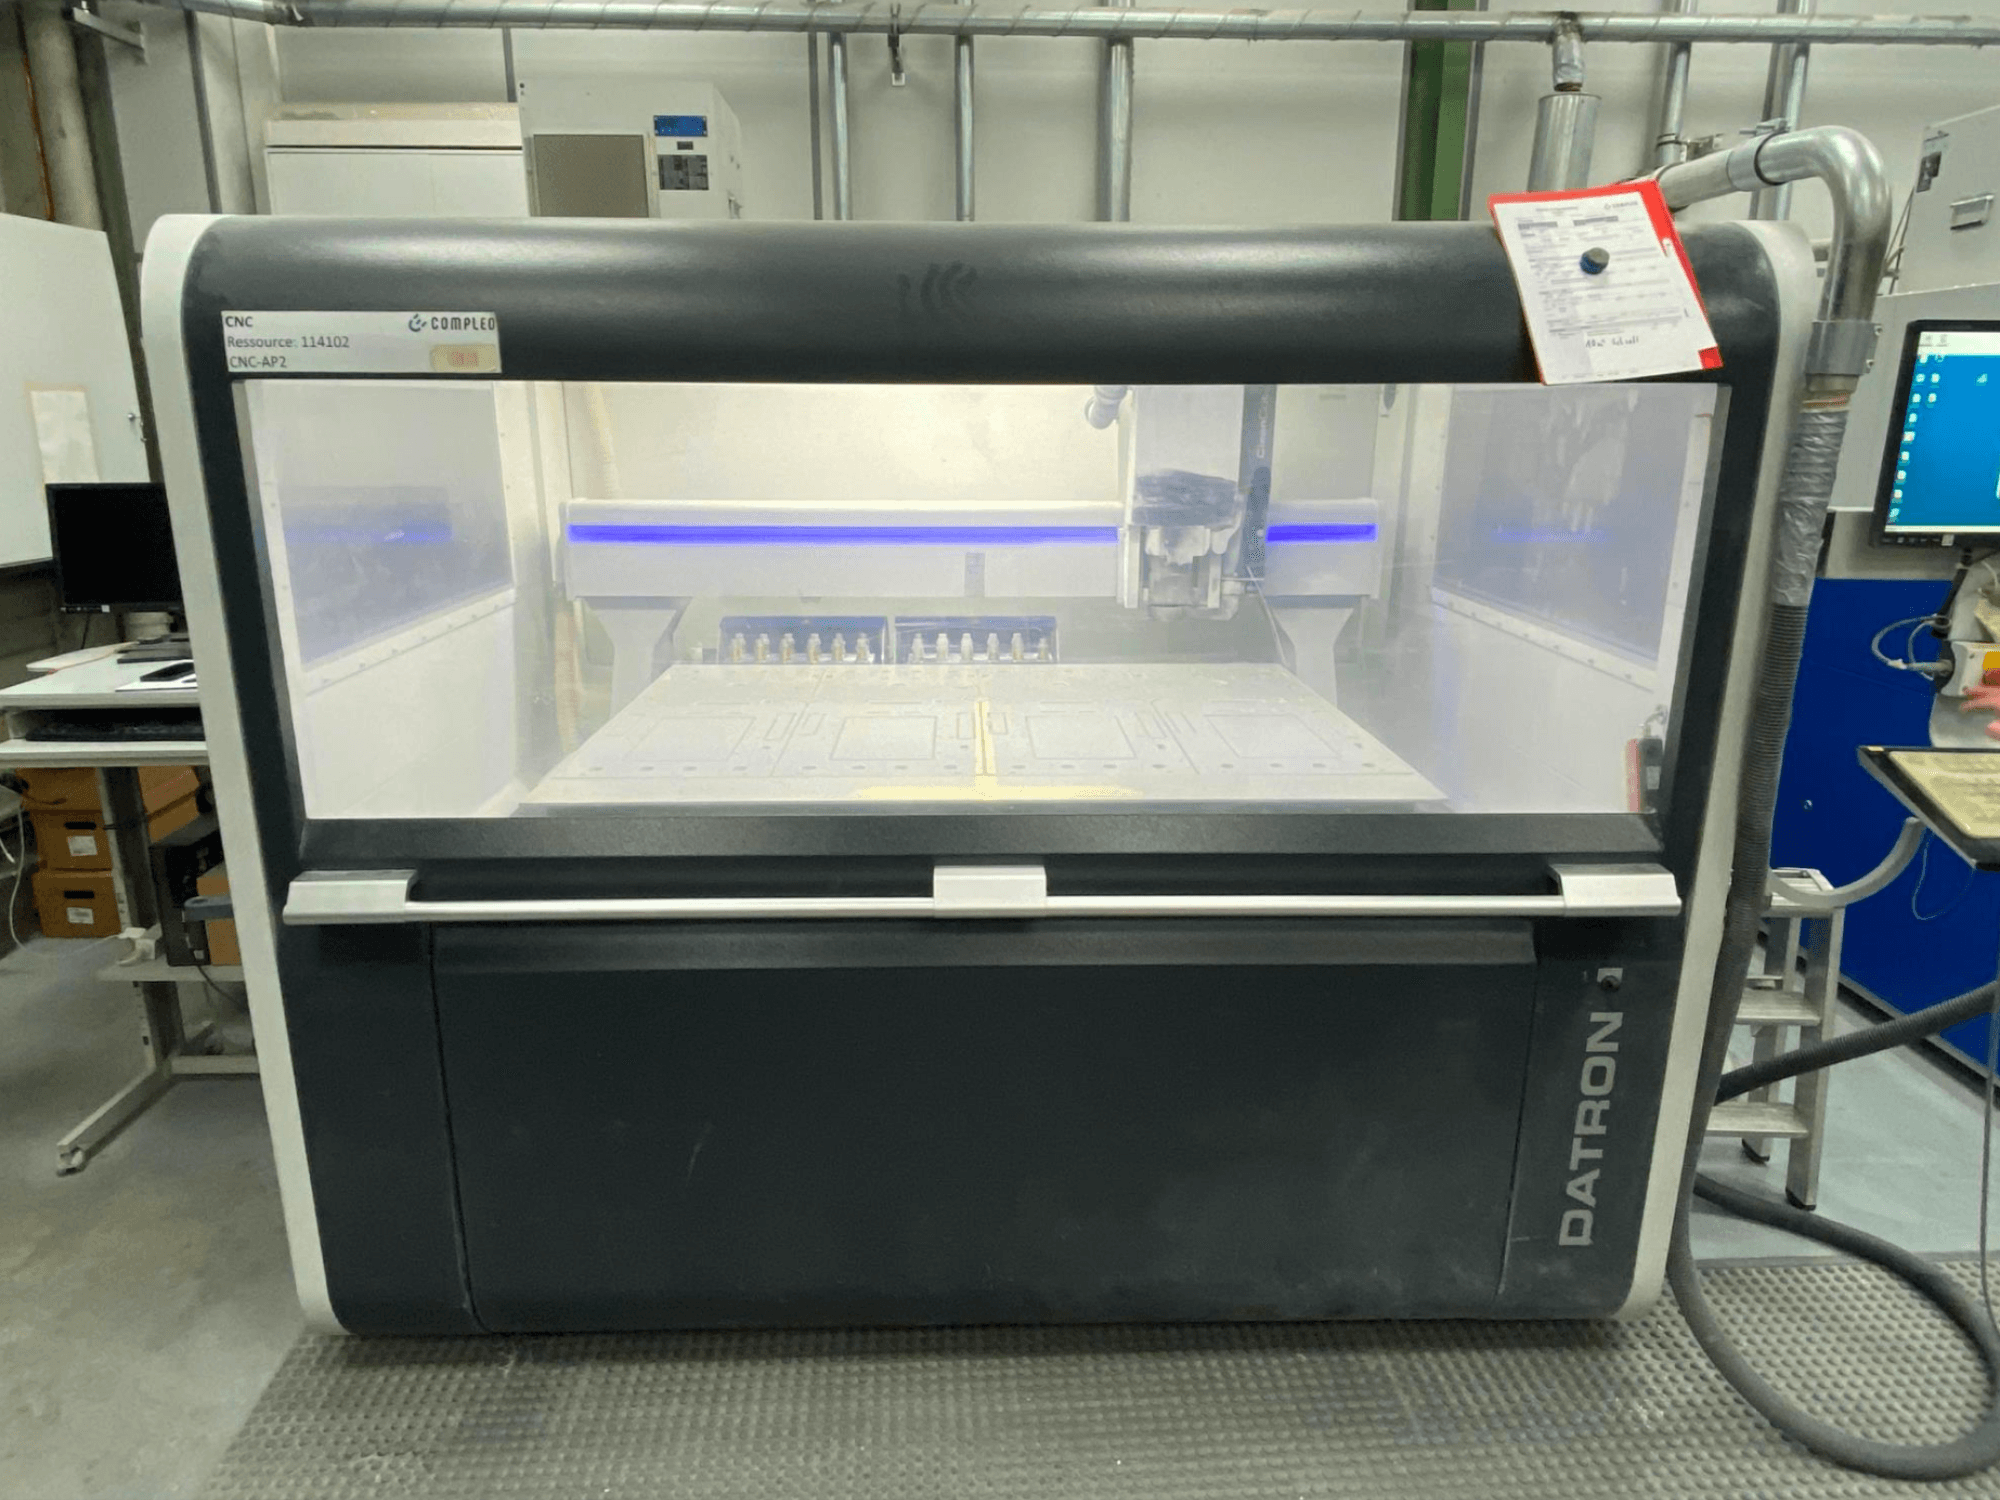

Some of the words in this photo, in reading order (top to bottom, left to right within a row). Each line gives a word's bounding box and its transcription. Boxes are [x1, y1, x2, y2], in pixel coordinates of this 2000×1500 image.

[225, 316, 253, 328] CNC
[431, 316, 495, 331] COMPLEO
[301, 336, 350, 348] 114102
[229, 356, 287, 368] CNC-AP2
[1559, 1012, 1623, 1246] DATRON
